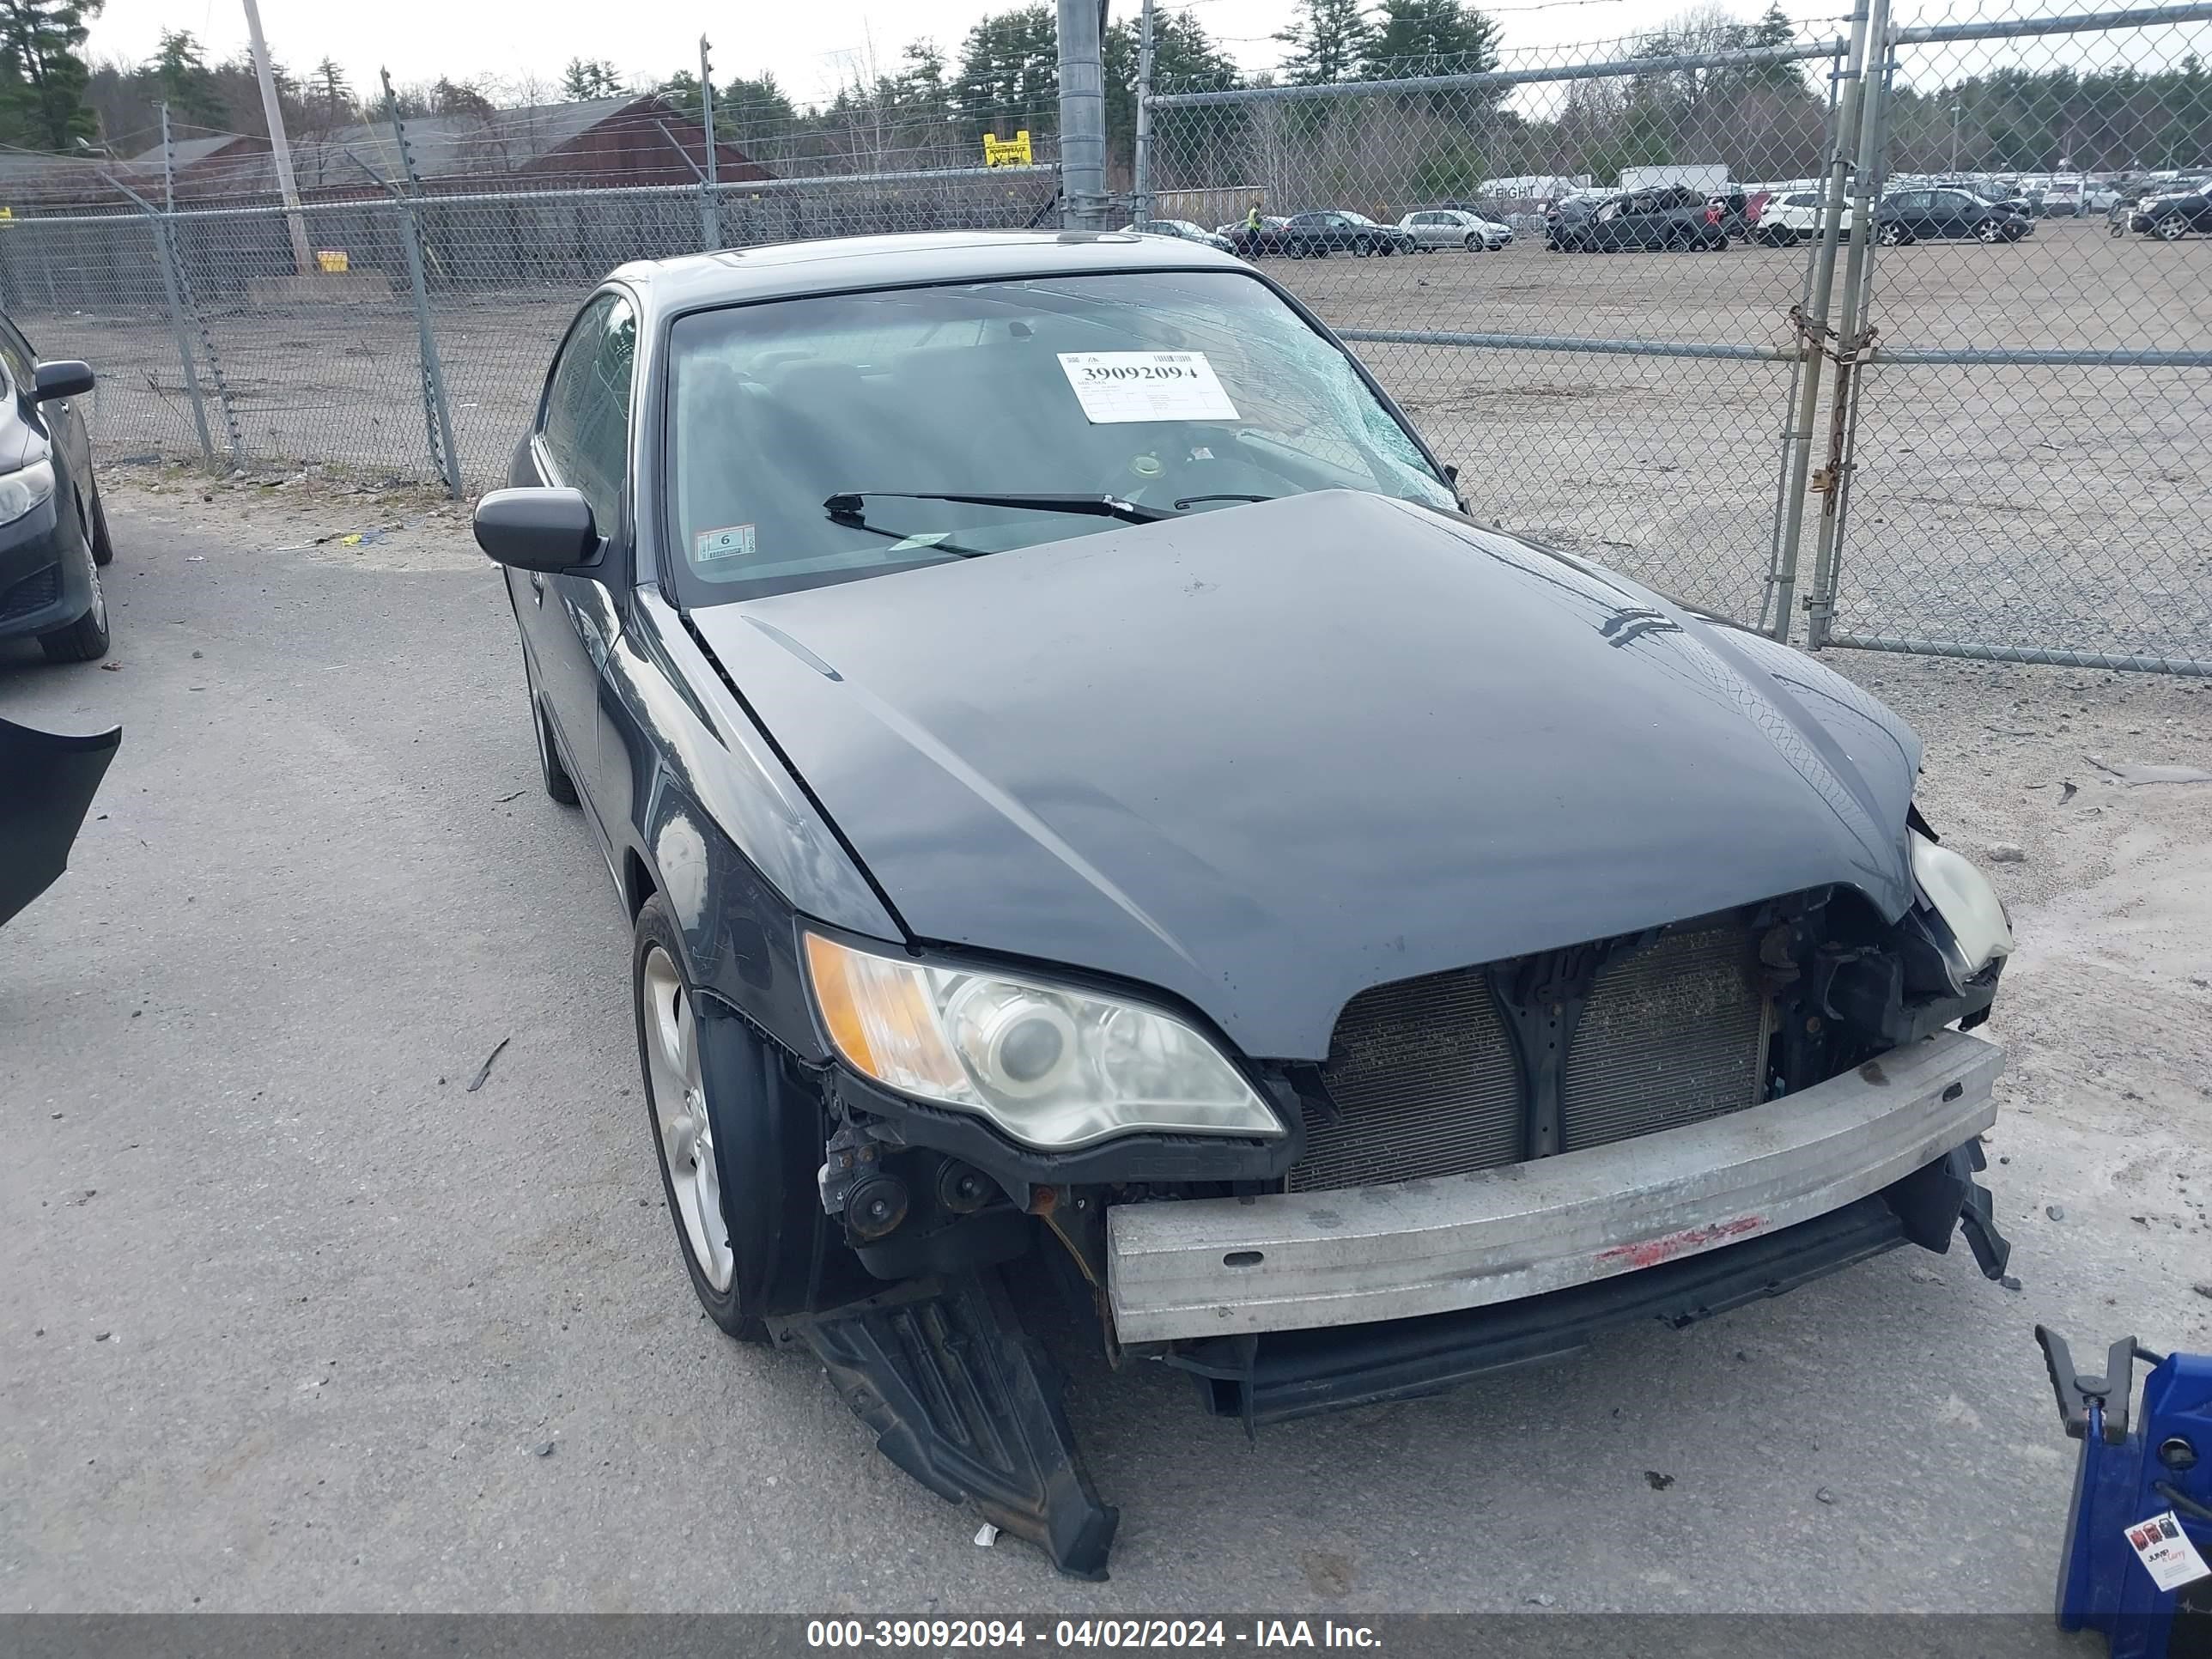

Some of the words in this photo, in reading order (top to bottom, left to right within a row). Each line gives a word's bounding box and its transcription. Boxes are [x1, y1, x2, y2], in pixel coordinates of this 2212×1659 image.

[1081, 366, 1198, 381] 39092094
[720, 534, 730, 545] 6
[2148, 1549, 2169, 1562] JUMP
